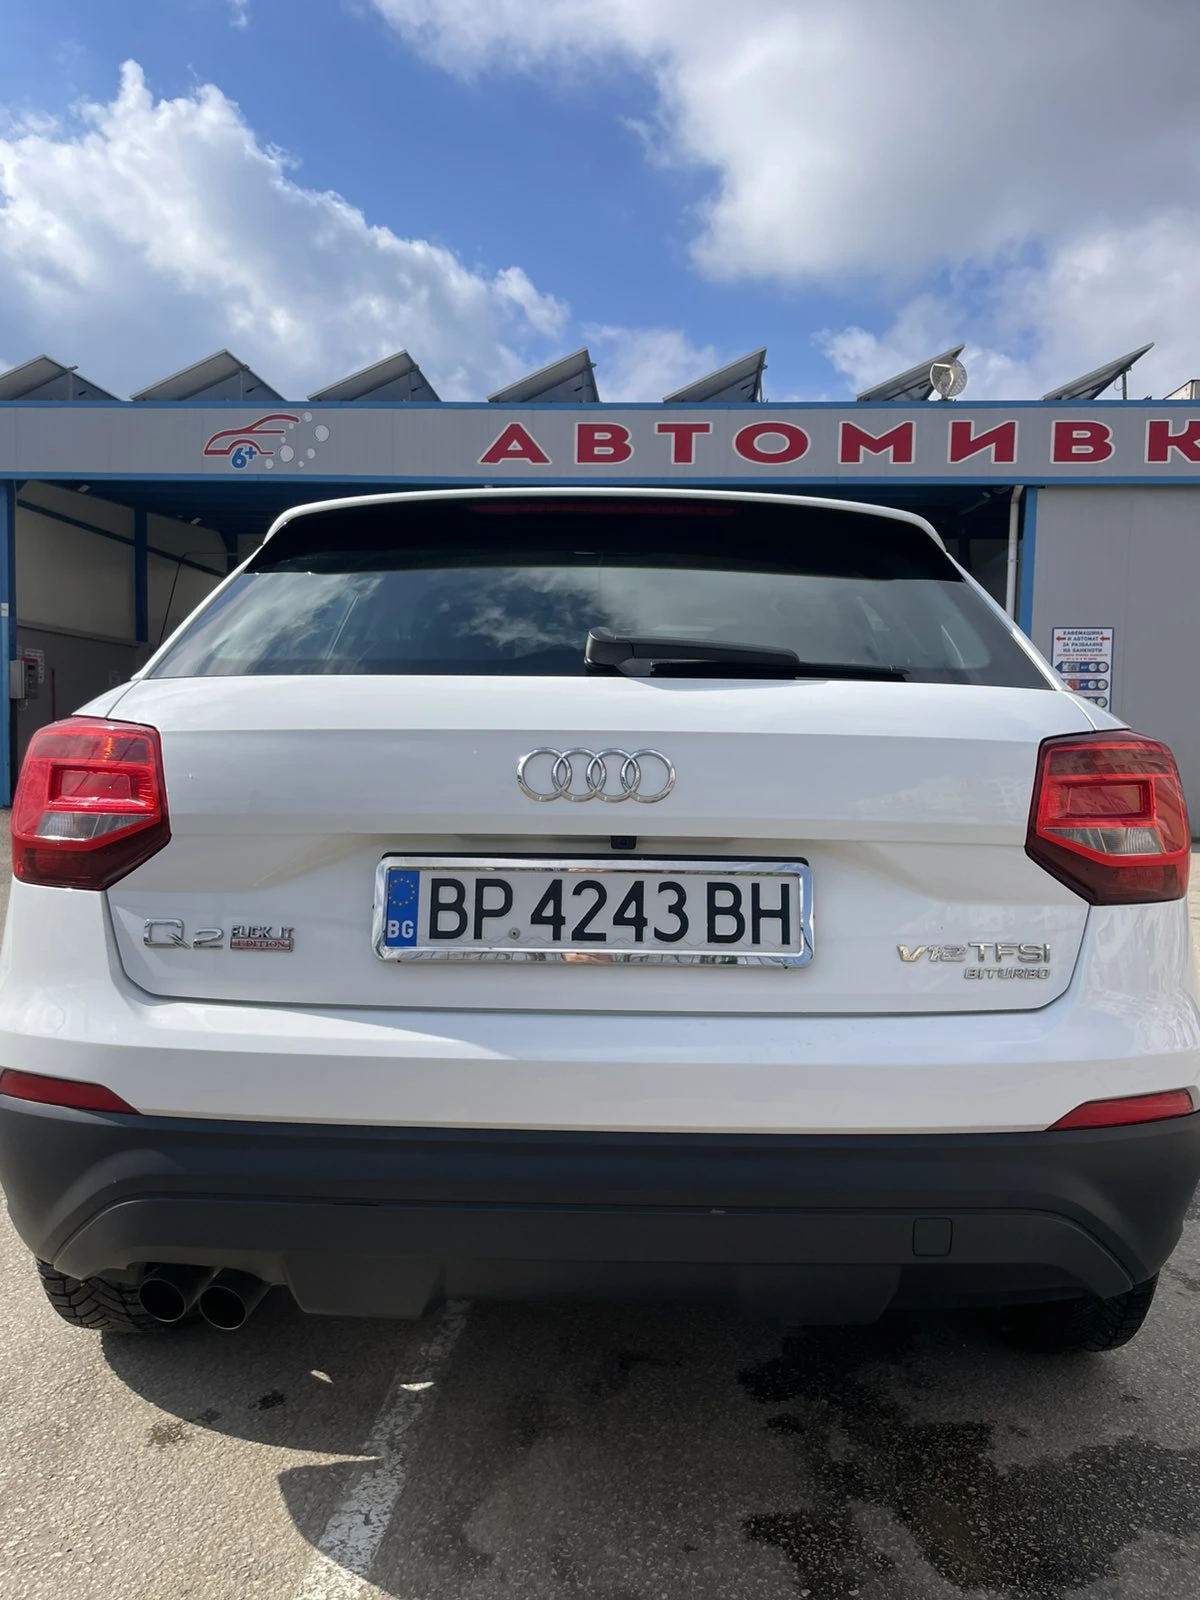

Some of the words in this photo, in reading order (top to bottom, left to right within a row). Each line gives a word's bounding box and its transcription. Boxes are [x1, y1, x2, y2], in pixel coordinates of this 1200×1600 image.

[477, 419, 1200, 465] АВТОМИВК
[231, 446, 257, 469] 6+
[428, 878, 513, 940] BP
[530, 879, 690, 942] 4243
[706, 881, 790, 945] BH
[231, 925, 272, 938] FUCK
[280, 926, 295, 938] IT
[386, 919, 414, 938] BG
[236, 939, 287, 948] EDITION
[963, 967, 1050, 980] BITURBO
